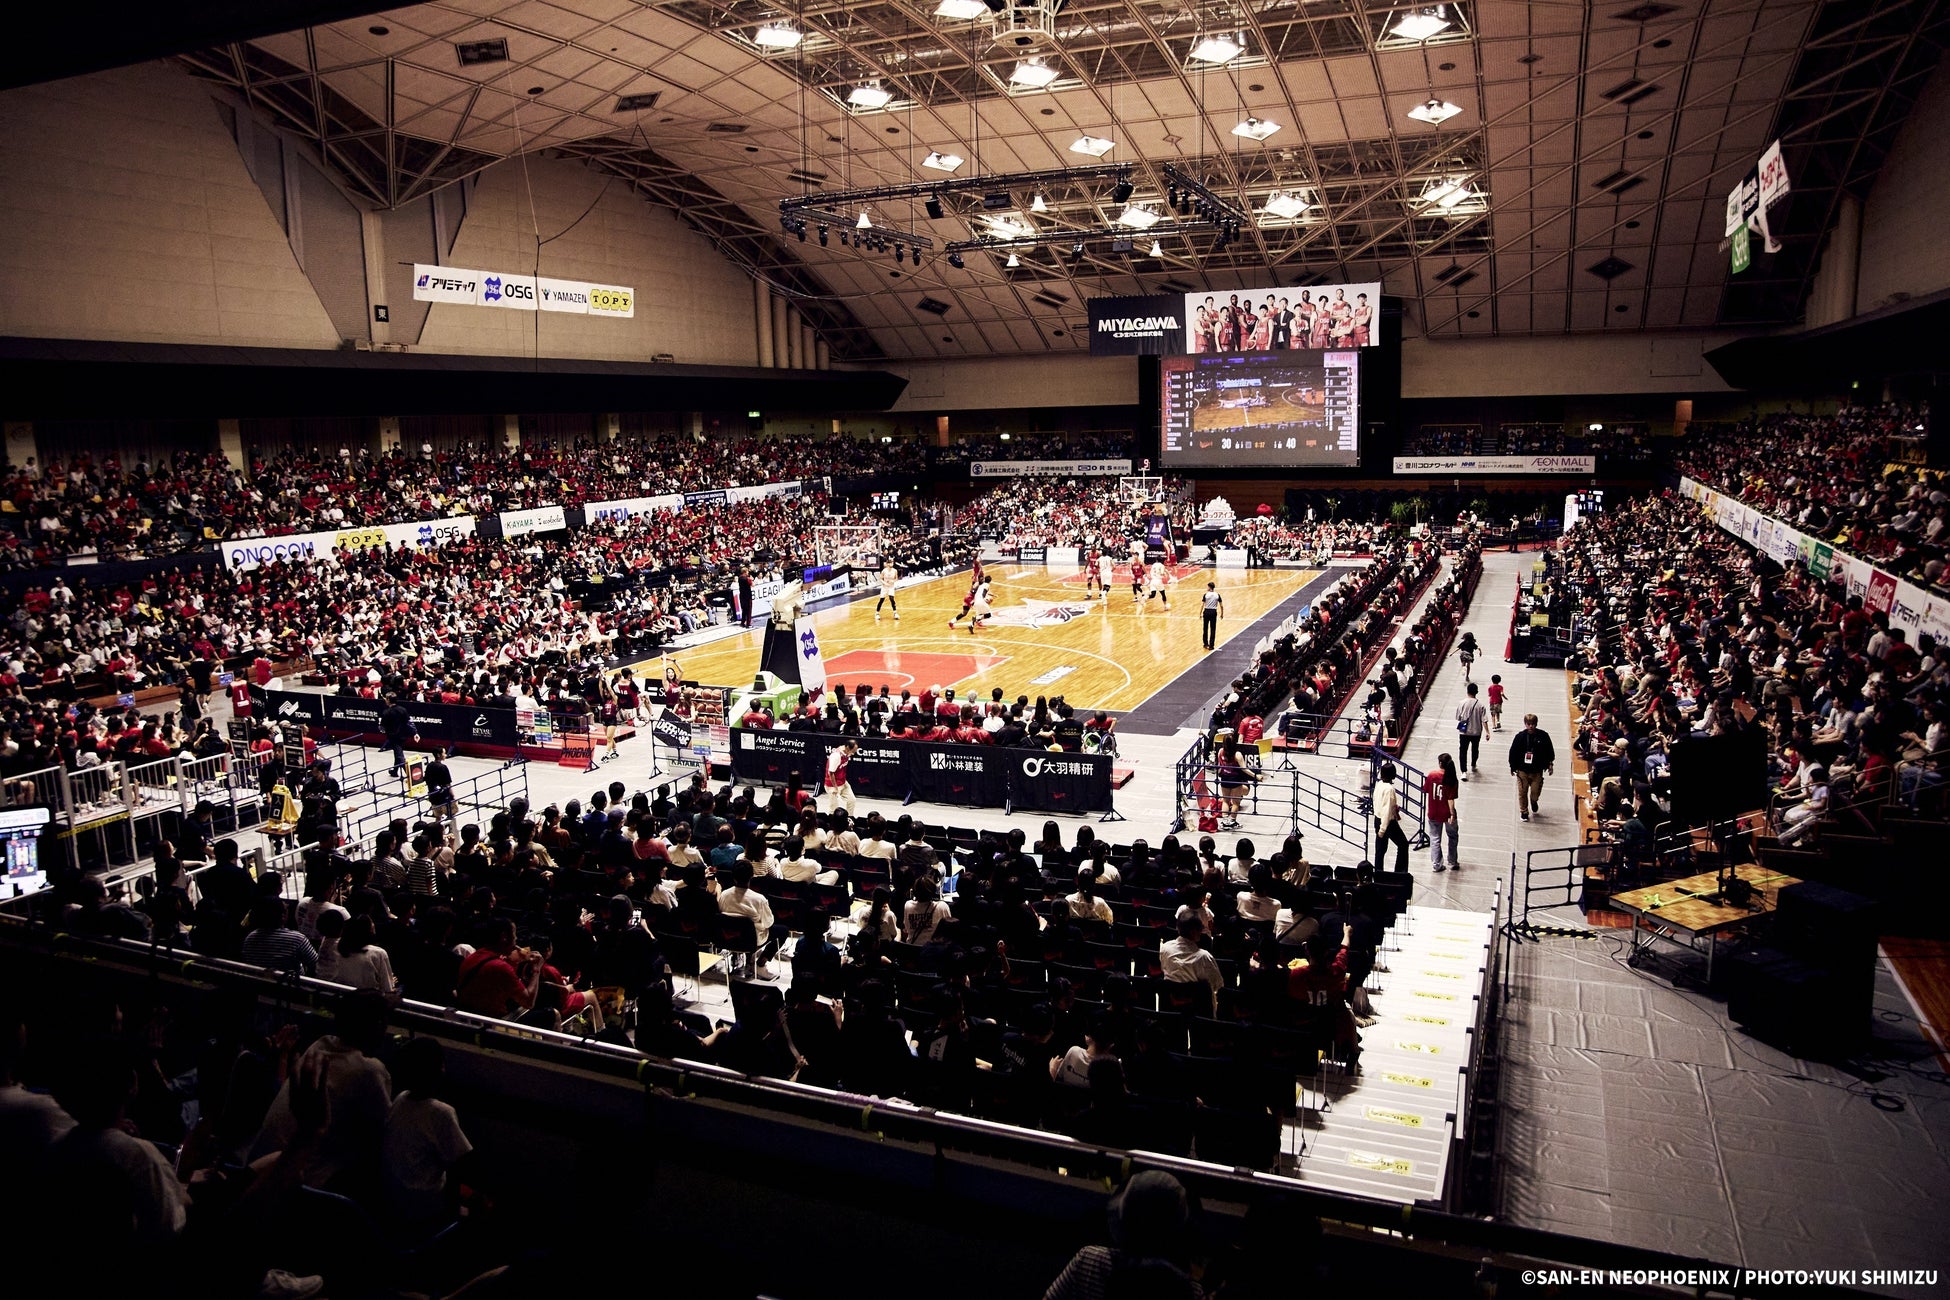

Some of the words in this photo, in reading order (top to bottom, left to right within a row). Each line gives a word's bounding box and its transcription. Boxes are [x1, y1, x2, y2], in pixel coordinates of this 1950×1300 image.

[431, 277, 476, 293] アツミテック
[504, 283, 533, 300] OSG
[553, 291, 588, 304] YAMAZEN
[593, 294, 630, 306] TOPY
[378, 309, 387, 319] 東
[1098, 316, 1178, 332] MIYAGAWA
[1221, 438, 1231, 449] 30
[1286, 437, 1296, 449] 40
[1143, 459, 1149, 468] 9
[1561, 457, 1590, 466] MALL
[506, 518, 533, 529] KAYAMA
[436, 526, 460, 539] OSG
[339, 533, 384, 546] TOPY
[231, 541, 314, 565] ONOCOM
[756, 736, 777, 745] Angel
[779, 737, 805, 748] Service
[856, 747, 877, 757] Cars
[945, 760, 984, 772] 小林建装
[1044, 761, 1094, 776] 大羽精研
[1432, 782, 1443, 801] 14
